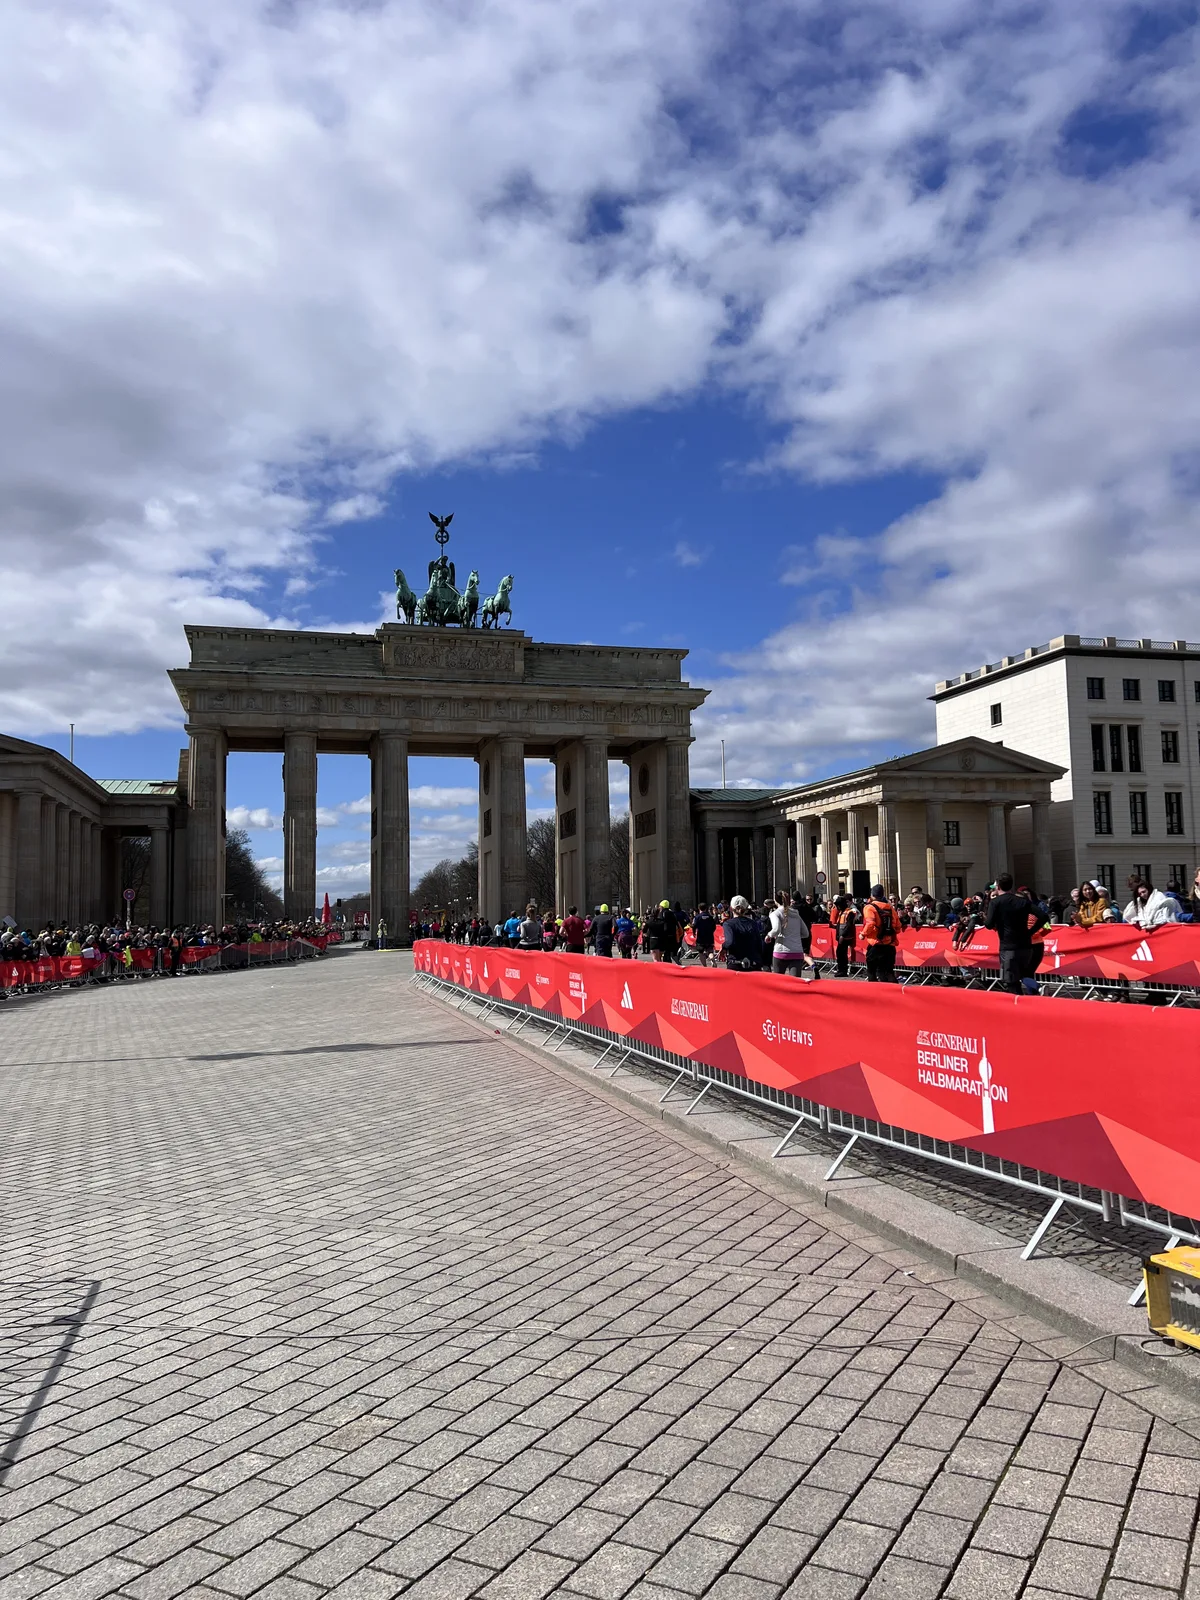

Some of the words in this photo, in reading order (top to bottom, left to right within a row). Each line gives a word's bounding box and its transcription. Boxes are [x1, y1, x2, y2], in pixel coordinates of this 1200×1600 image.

[679, 1000, 709, 1022] GENERALI
[762, 1020, 777, 1041] SCC
[781, 1027, 813, 1047] EVENTS
[930, 1032, 978, 1054] GENERALI
[917, 1050, 968, 1073] BERLINER
[918, 1069, 1008, 1103] HALBMARATHON
